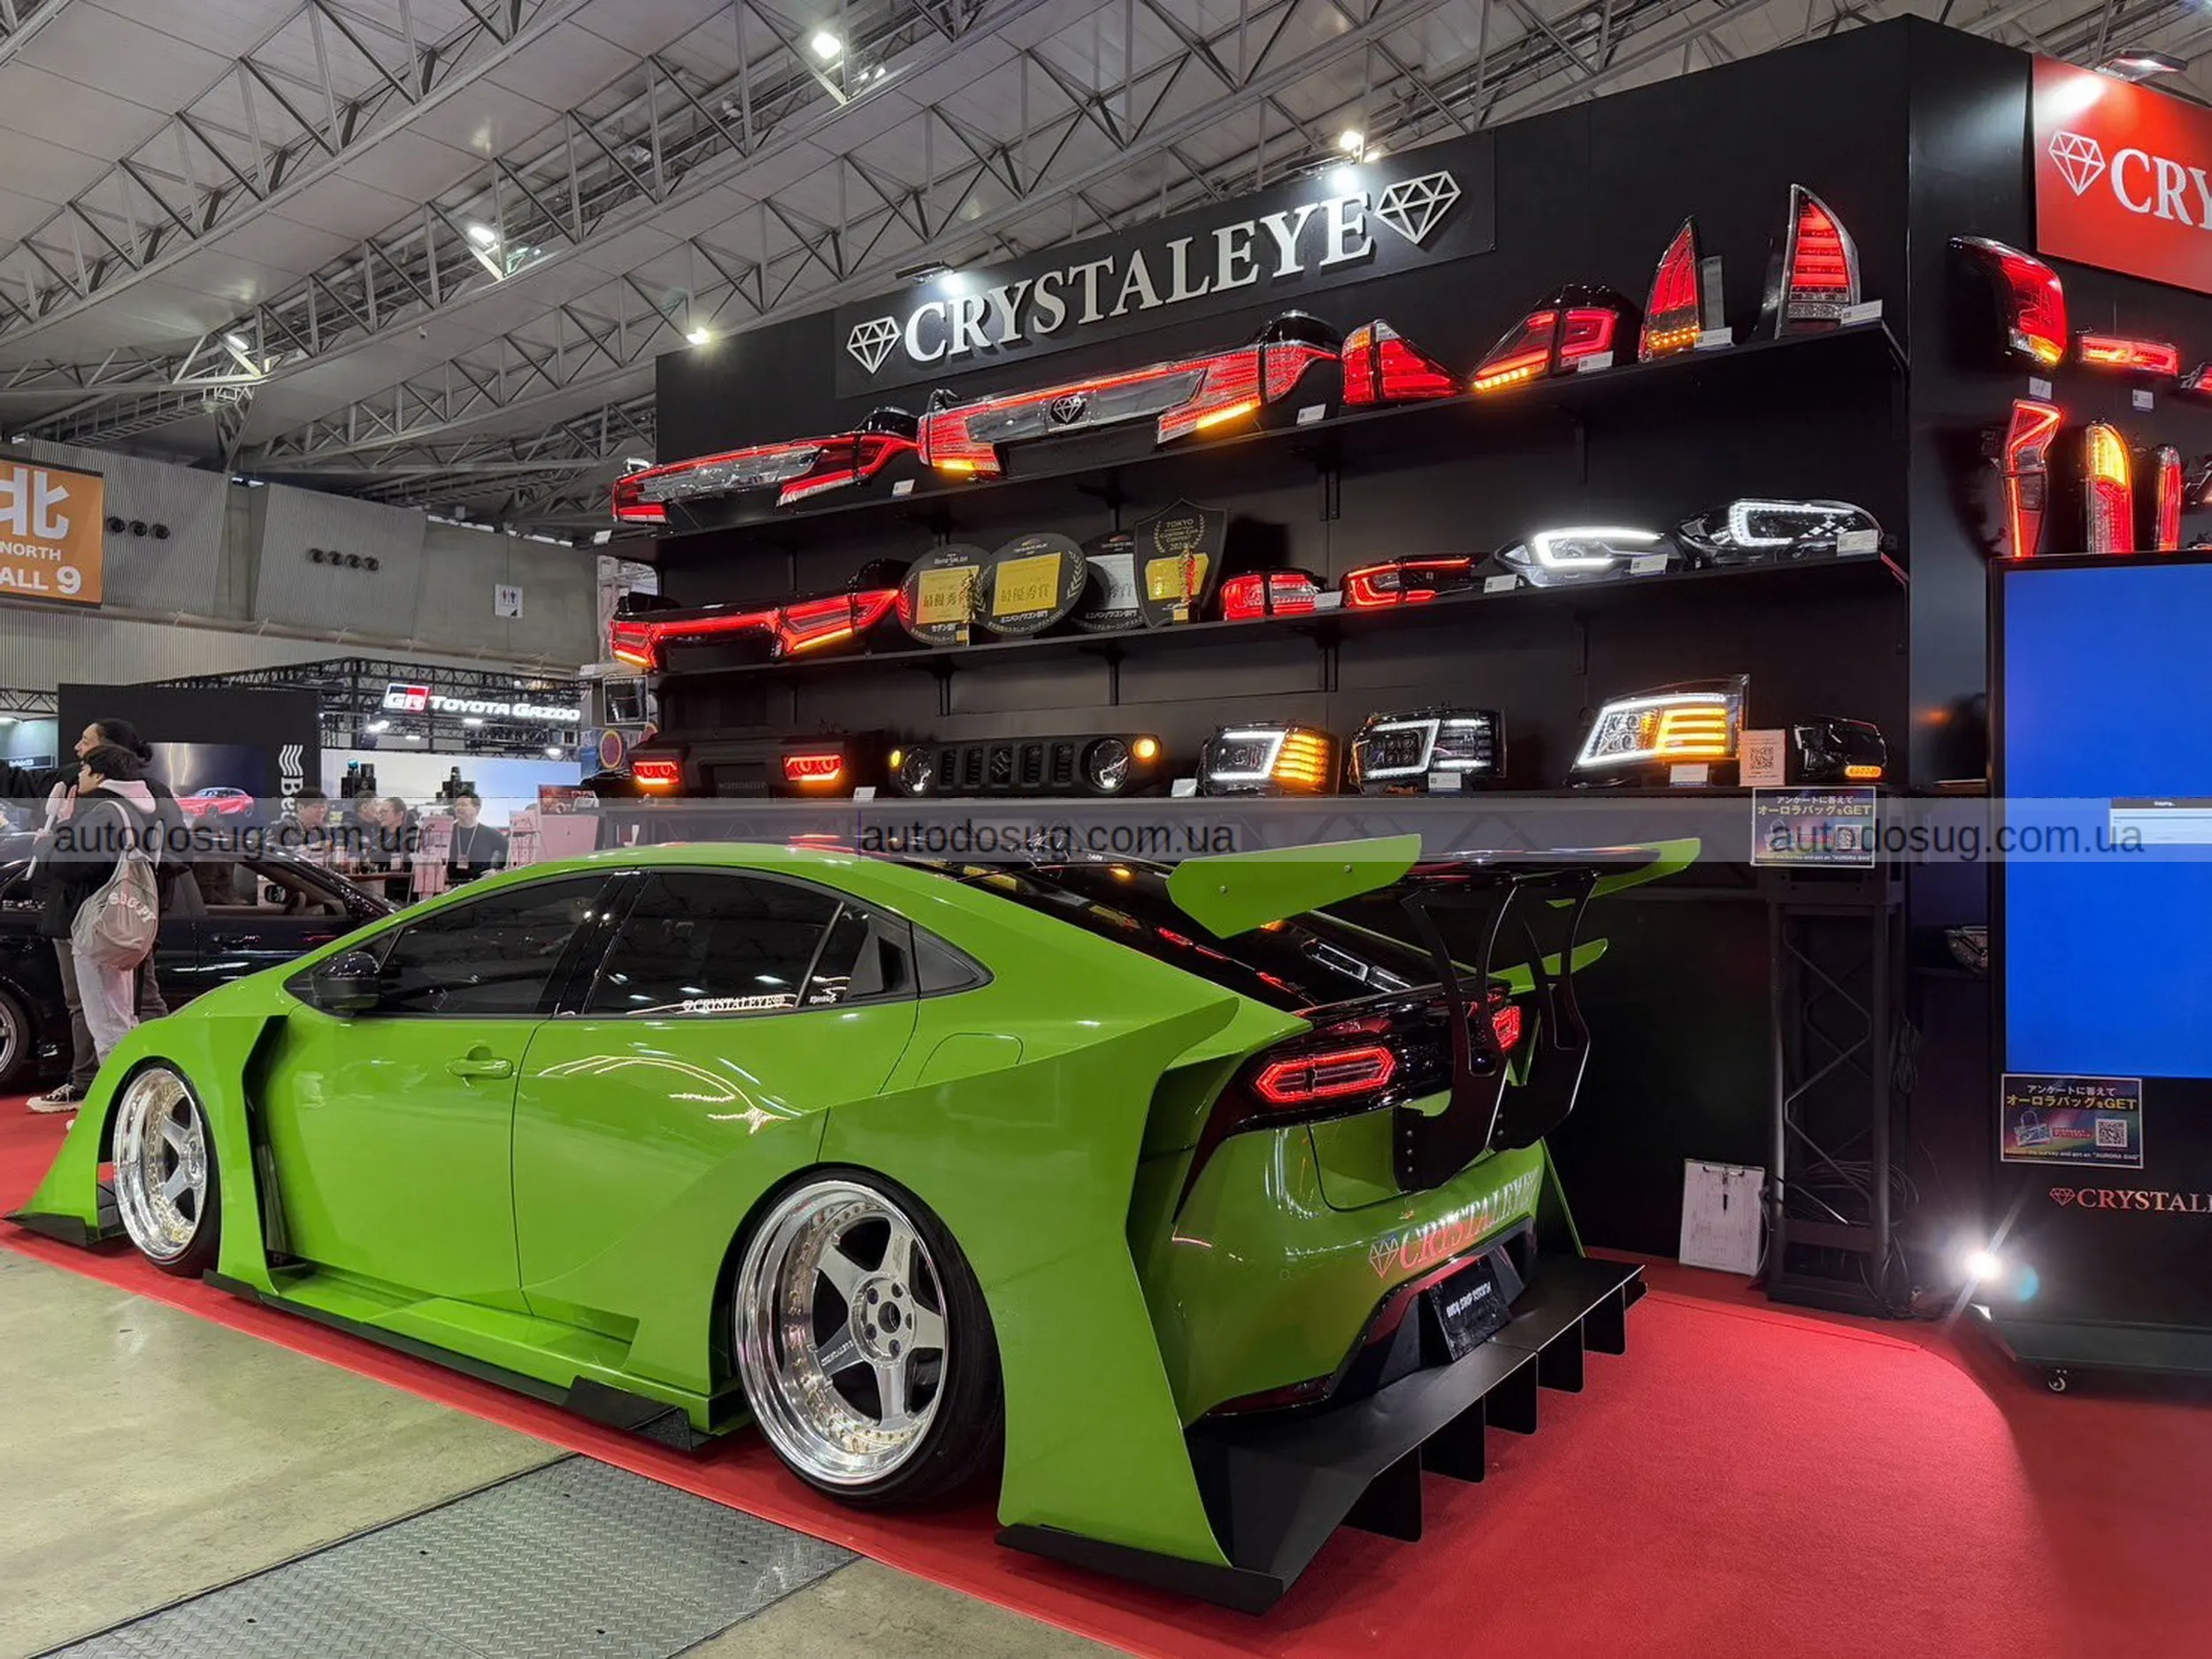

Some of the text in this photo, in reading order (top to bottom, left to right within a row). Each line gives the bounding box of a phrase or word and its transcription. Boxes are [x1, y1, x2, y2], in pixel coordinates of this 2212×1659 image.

[2111, 148, 2212, 230] CRY
[904, 190, 1374, 362] CRYSTALEYE
[0, 466, 70, 540] 北
[0, 539, 61, 562] NORTH
[57, 565, 81, 595] 9
[387, 693, 581, 721] GR TOYOTA GAZOO
[693, 996, 776, 1011] CRYSTALEYE
[2007, 1094, 2138, 1110] オーロラバッグをGET
[2027, 1085, 2117, 1097] アンケートに答えて
[1400, 1165, 1540, 1271] CRYSTALEYE
